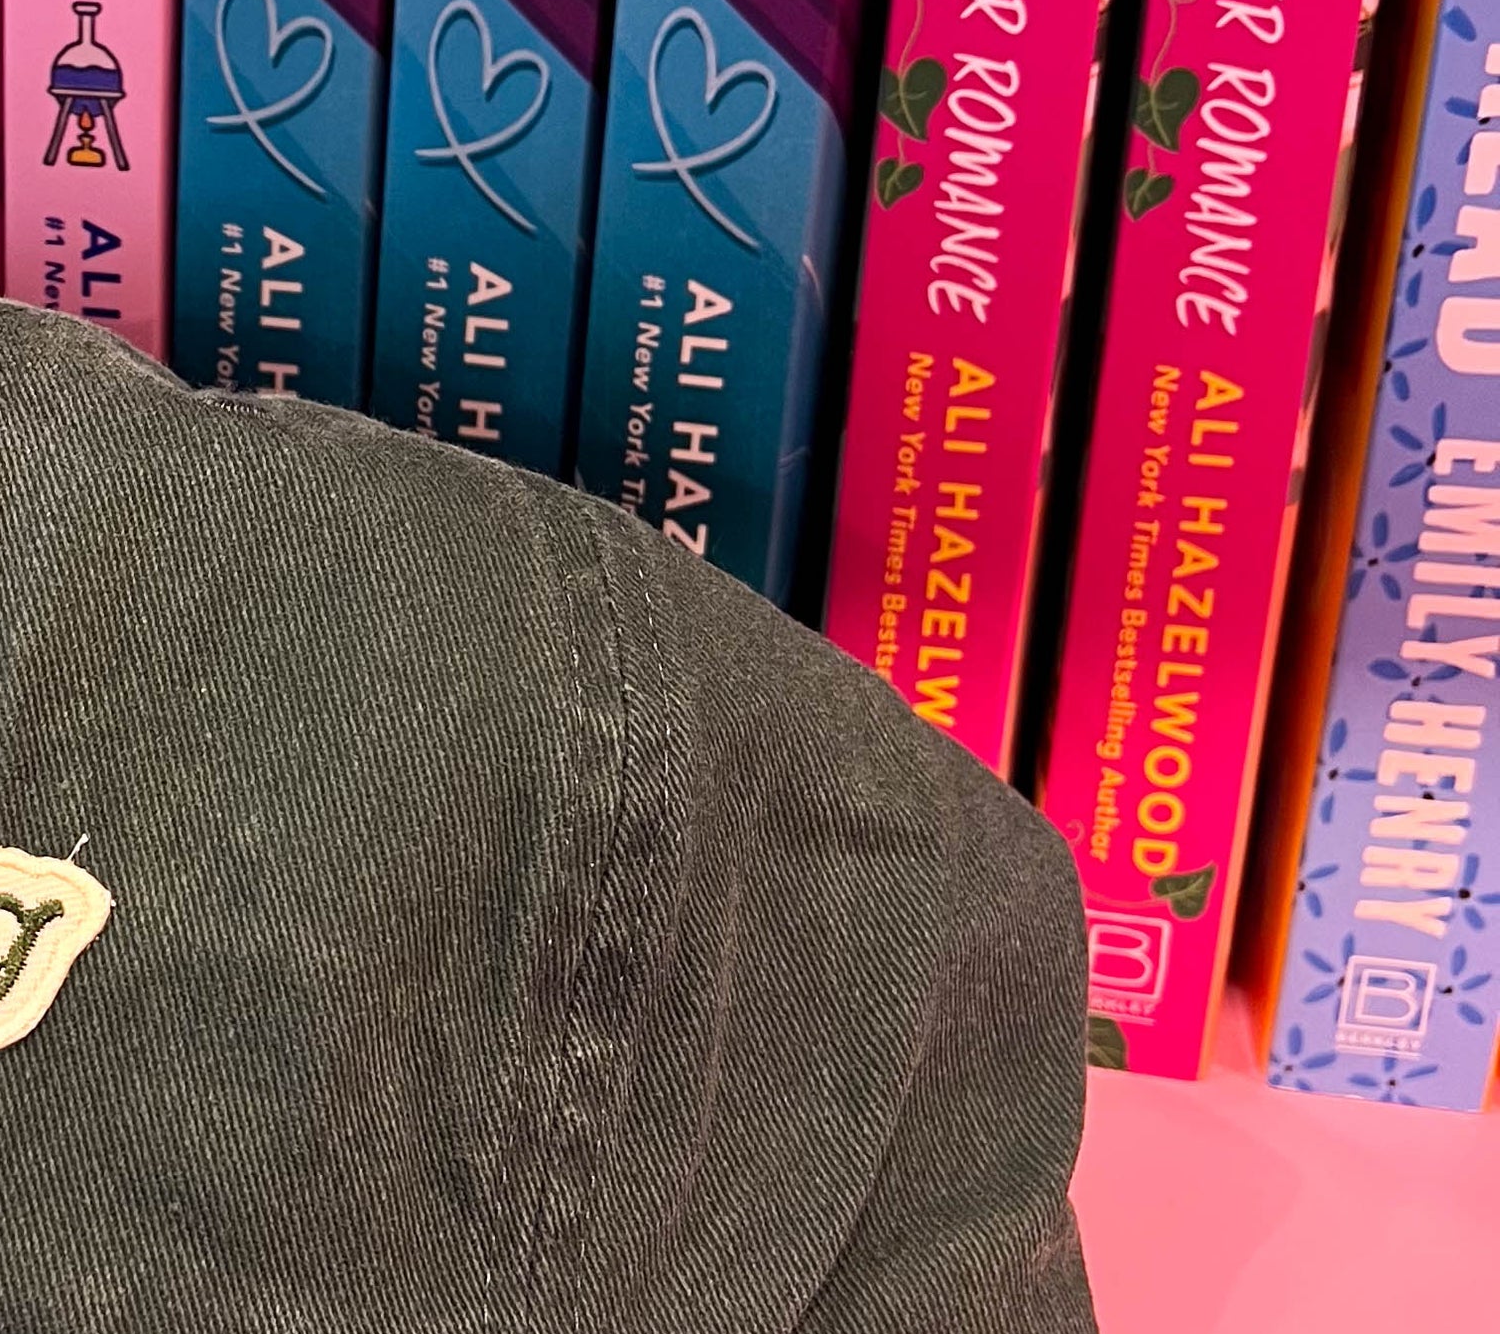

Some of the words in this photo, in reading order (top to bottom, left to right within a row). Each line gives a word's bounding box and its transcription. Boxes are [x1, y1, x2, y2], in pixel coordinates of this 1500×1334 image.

[927, 51, 1021, 325] ROMANCE
[1175, 62, 1277, 338] ROMANCE
[44, 216, 66, 247] #1
[82, 219, 123, 322] ALI
[220, 222, 245, 257] #1
[424, 255, 450, 293] #1
[217, 267, 242, 335] New
[257, 224, 307, 332] ALI
[464, 260, 514, 369] ALI
[641, 273, 668, 310] #1
[420, 302, 448, 372] New
[633, 321, 663, 394] New
[676, 277, 735, 392] ALI
[902, 350, 935, 422] New
[942, 356, 997, 454] ALI
[1150, 364, 1182, 431] New
[1187, 368, 1245, 470] ALI
[625, 402, 655, 468] York
[893, 430, 928, 497] York
[1136, 436, 1171, 508] York
[883, 504, 918, 586] Times
[1125, 513, 1162, 602] Times
[1400, 438, 1500, 680] EMILY
[912, 480, 984, 729] HAZELW
[1096, 606, 1149, 763] Bestselling
[1132, 493, 1230, 880] HAZELWOOD
[1088, 763, 1128, 865] Author
[1353, 699, 1489, 941] HENRY
[1088, 923, 1155, 988] B
[1355, 968, 1418, 1026] B
